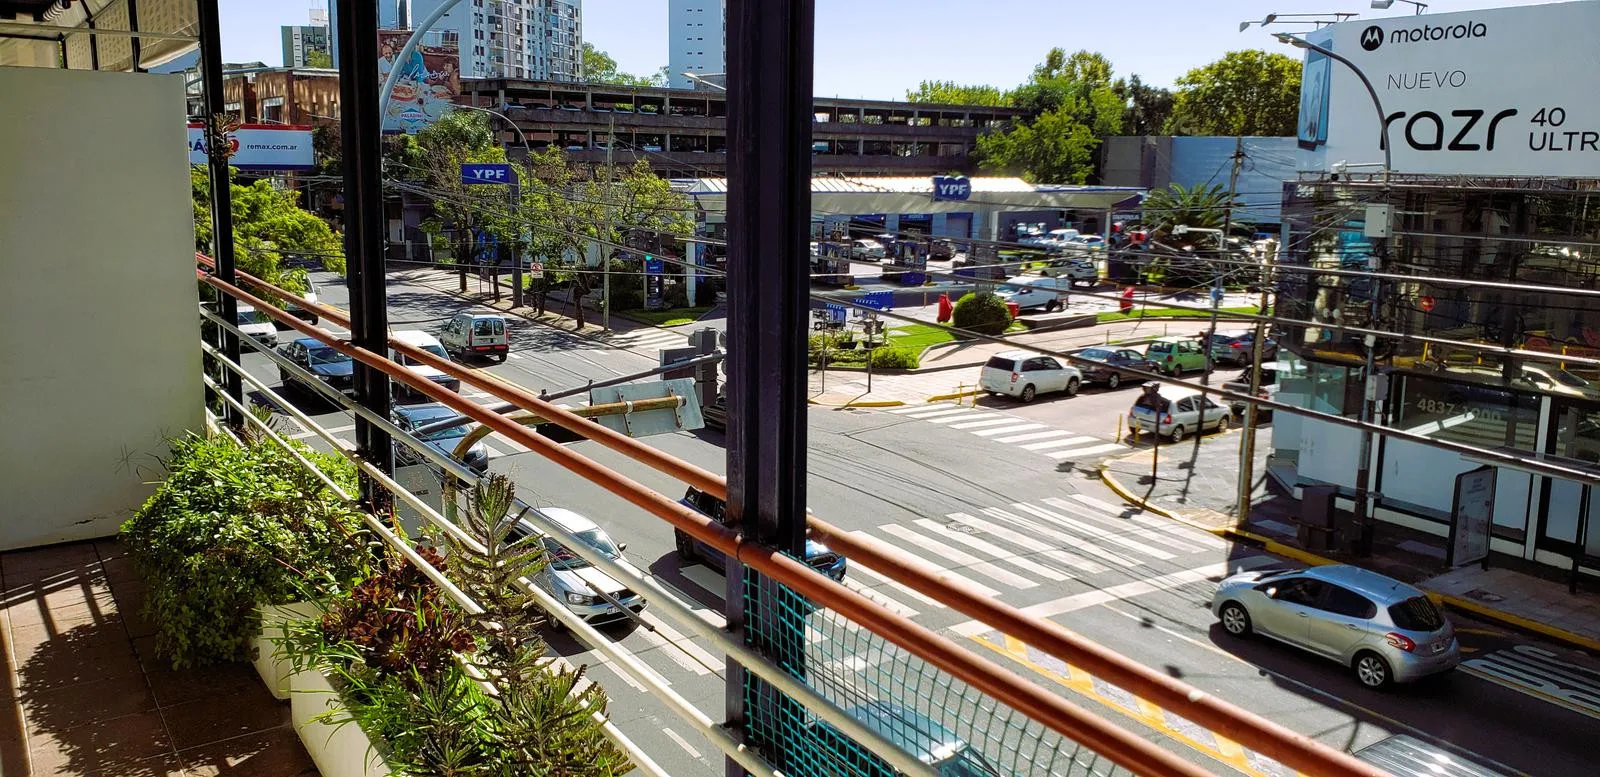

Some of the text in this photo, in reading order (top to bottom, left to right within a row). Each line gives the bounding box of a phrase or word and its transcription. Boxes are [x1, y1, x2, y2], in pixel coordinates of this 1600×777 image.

[1390, 21, 1487, 44] motorola
[1387, 69, 1467, 91] NUEVO
[1379, 107, 1566, 151] razr 40
[246, 142, 298, 151] remax.com.ar
[472, 169, 505, 179] YPF
[939, 184, 967, 195] YPF
